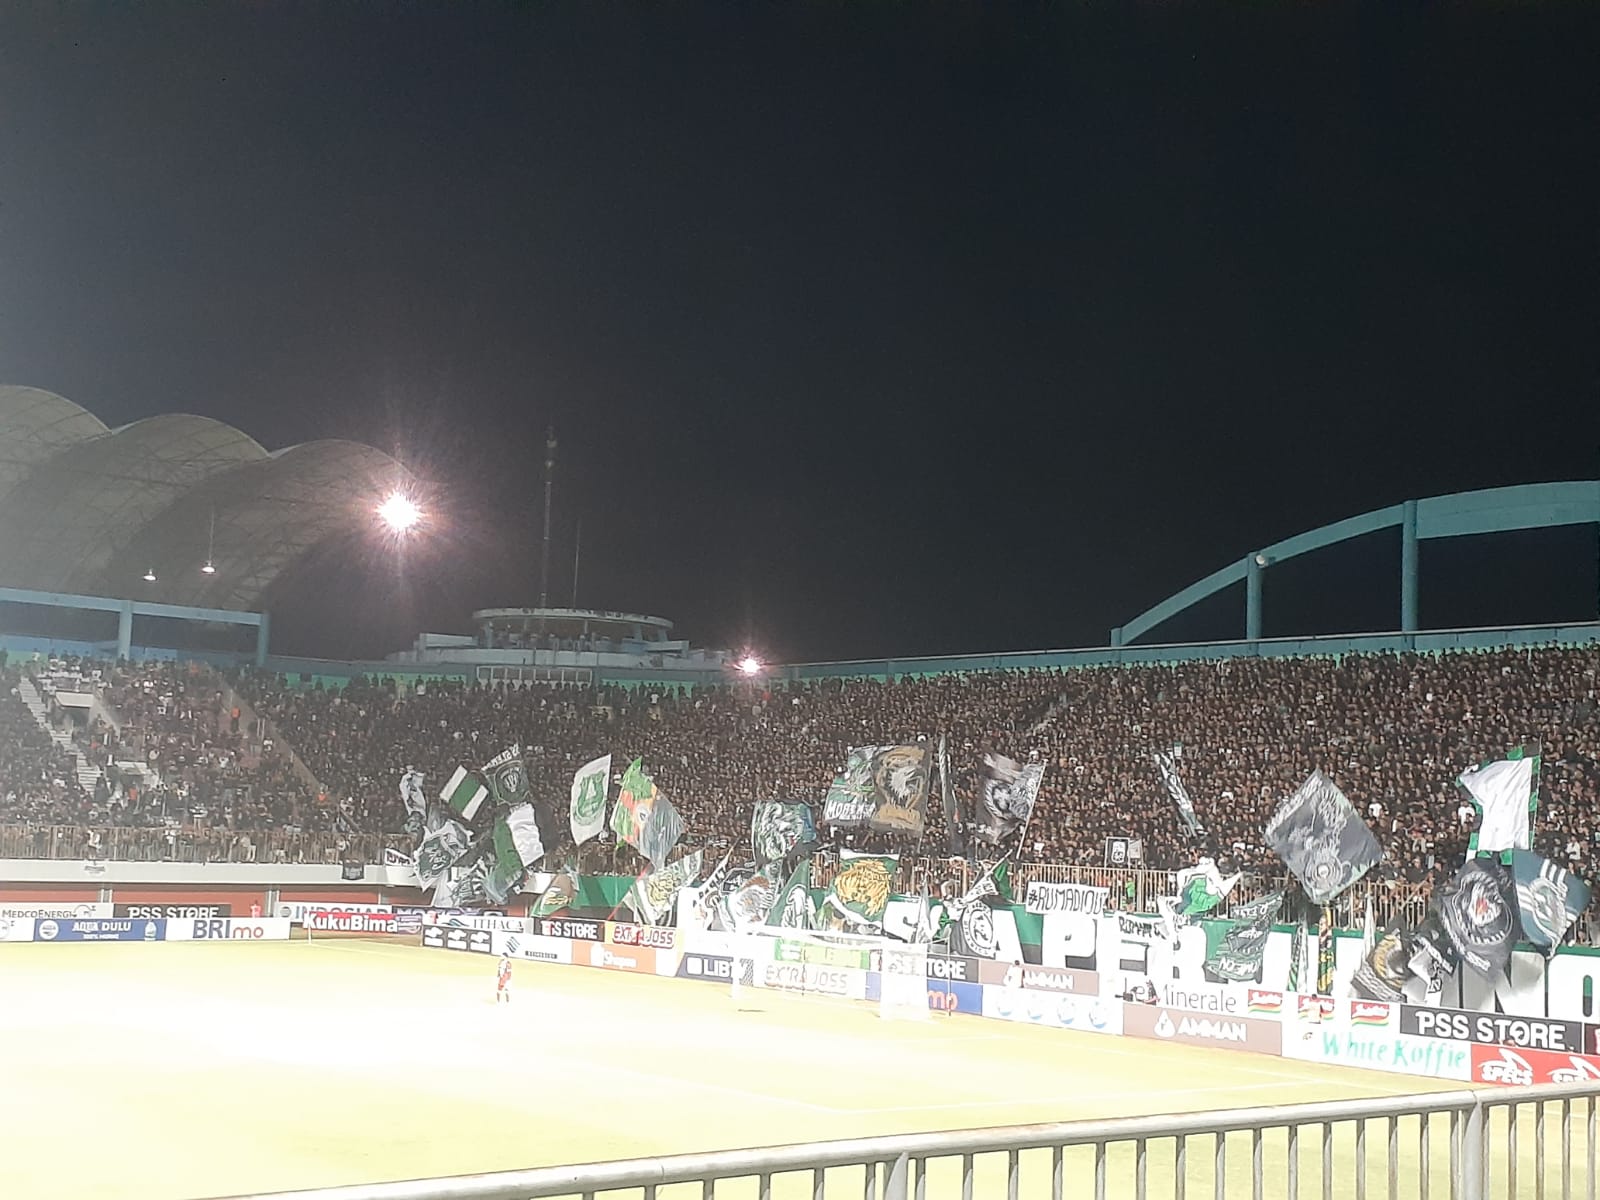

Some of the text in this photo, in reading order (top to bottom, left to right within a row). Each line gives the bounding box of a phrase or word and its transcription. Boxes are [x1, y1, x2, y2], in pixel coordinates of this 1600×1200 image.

[127, 906, 220, 919] PSS STORE
[302, 913, 398, 933] KukuBima
[72, 922, 132, 933] AQUA DULU
[563, 921, 598, 940] STORE
[1177, 1016, 1247, 1042] AMMAN
[1415, 1011, 1566, 1050] PSS STORE
[1322, 1031, 1466, 1076] White Koffie
[1480, 1064, 1534, 1086] SPECS
